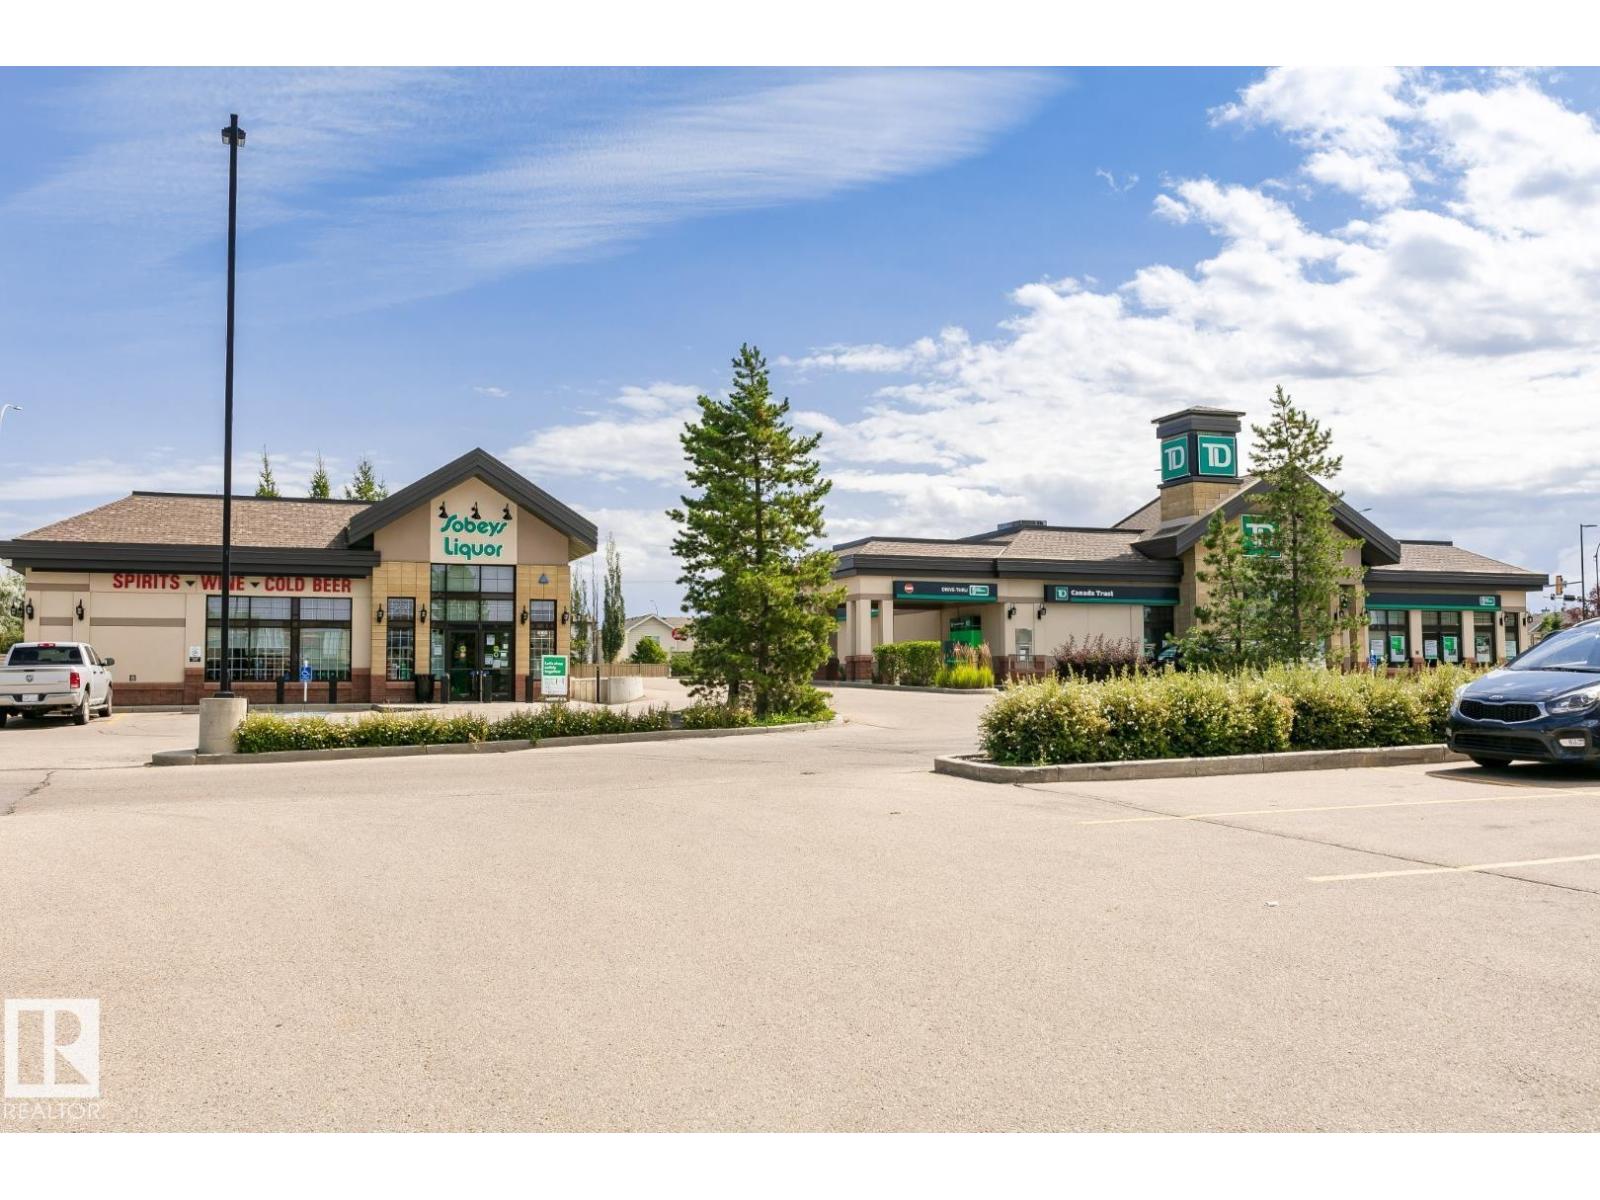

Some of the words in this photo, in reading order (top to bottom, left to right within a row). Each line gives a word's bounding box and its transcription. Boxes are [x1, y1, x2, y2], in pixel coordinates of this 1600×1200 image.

[1164, 446, 1185, 471] TD
[1202, 443, 1232, 468] TD
[440, 514, 507, 536] Sobeys
[443, 537, 502, 560] Liquor
[112, 573, 181, 590] SPIRITS
[264, 577, 305, 592] COLD
[312, 577, 353, 594] BEER
[1070, 589, 1095, 597] Canada
